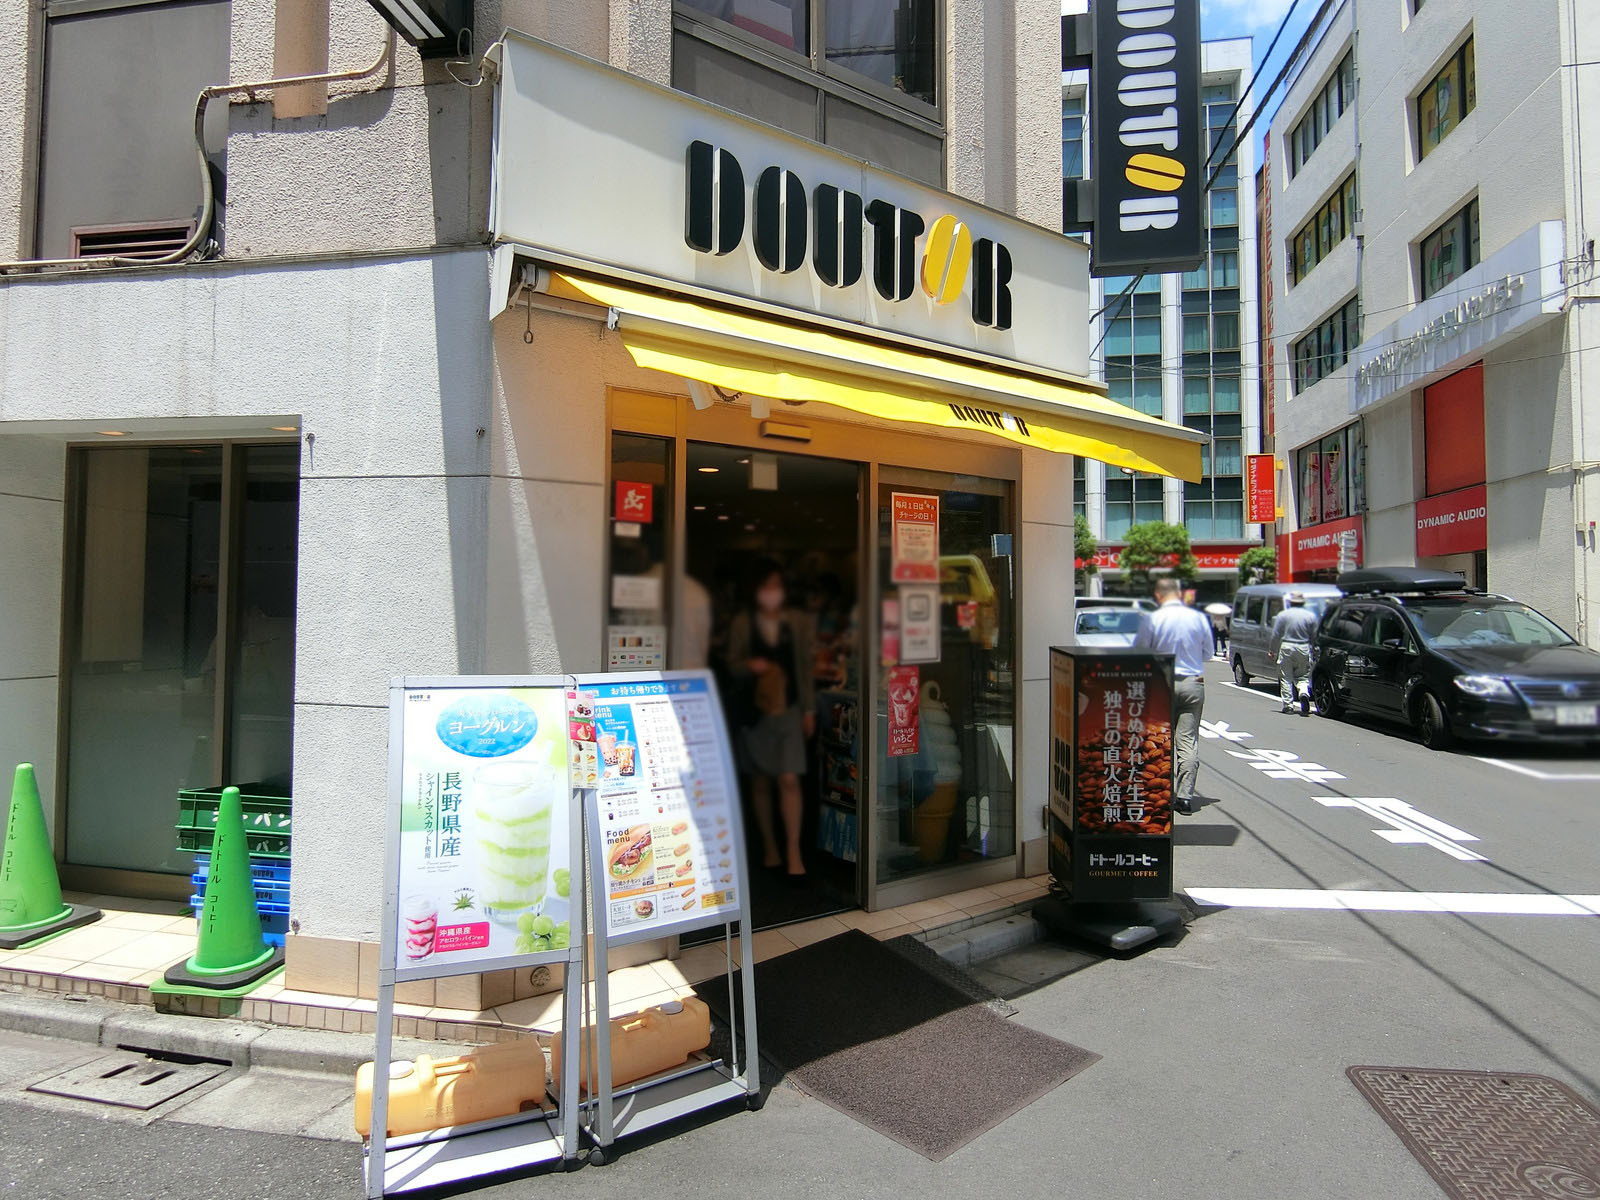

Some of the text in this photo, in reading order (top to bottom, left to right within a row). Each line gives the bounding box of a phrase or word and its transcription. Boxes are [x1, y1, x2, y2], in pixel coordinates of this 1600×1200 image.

[1116, 0, 1186, 232] DOUTOR
[684, 140, 1013, 331] DOUTOR
[949, 403, 1030, 437] DOUTOR
[1417, 507, 1486, 530] DYNAMIC AUDIO
[1298, 535, 1330, 550] DYNAMIC
[594, 705, 611, 713] rink
[449, 717, 527, 736] ヨーグルン
[1103, 690, 1122, 823] 独自の直火焙煎
[1126, 681, 1145, 823] 選びぬかれた生豆
[440, 771, 462, 857] 長野県産
[5, 803, 19, 881] ドトール コーヒー
[606, 829, 630, 838] Food
[607, 837, 631, 845] menu
[1089, 853, 1158, 866] ドトールコーヒー
[209, 834, 226, 934] ドトール コーヒー
